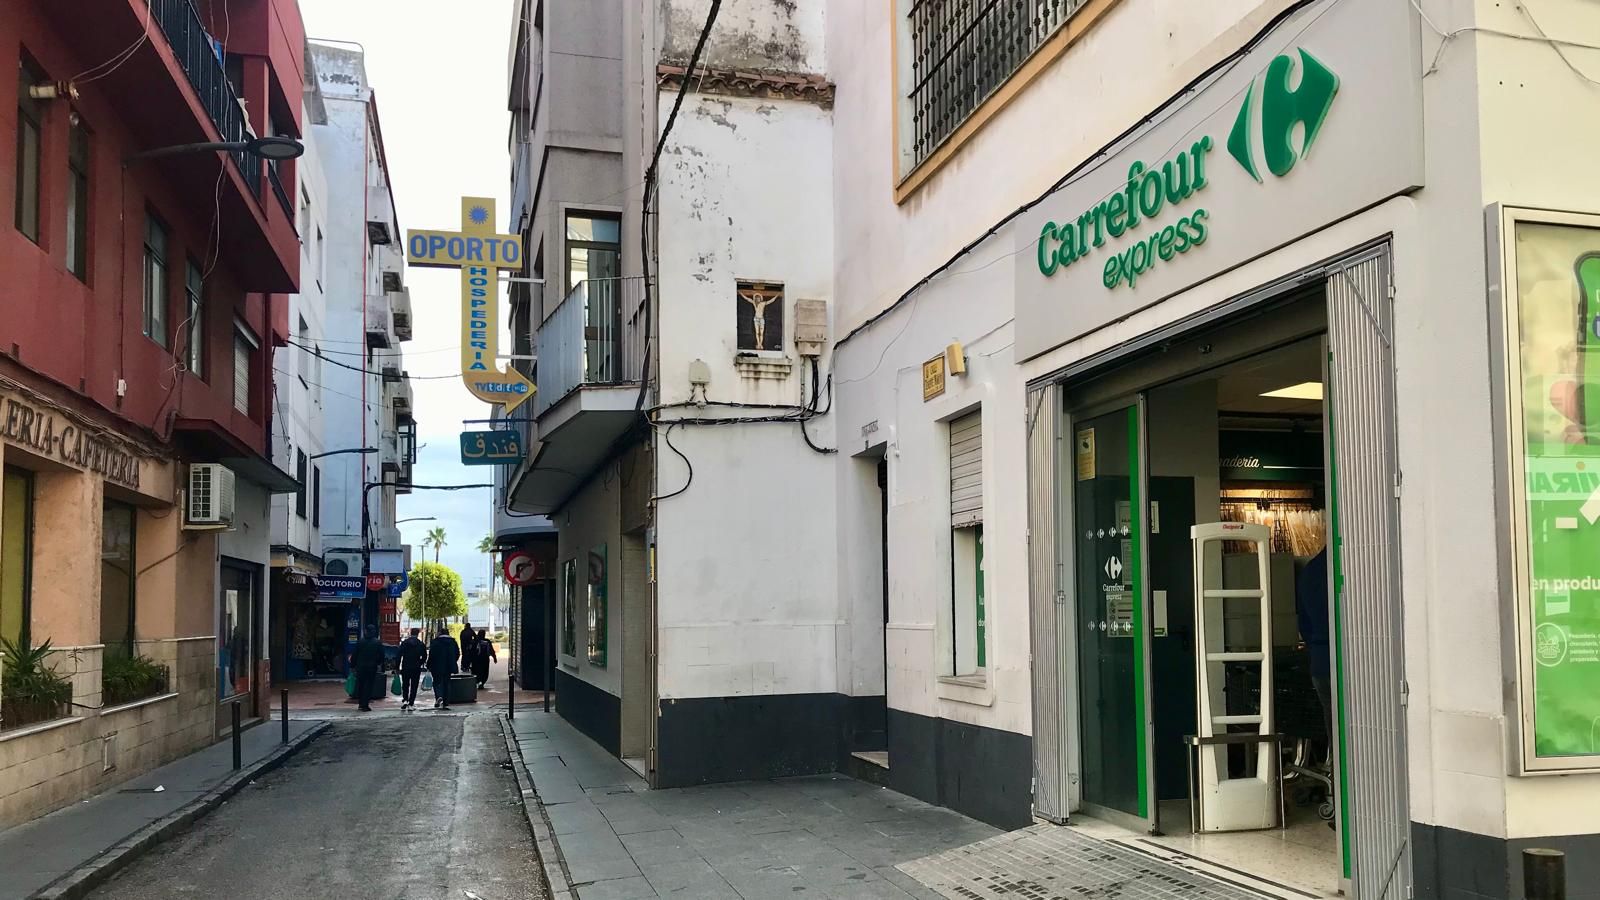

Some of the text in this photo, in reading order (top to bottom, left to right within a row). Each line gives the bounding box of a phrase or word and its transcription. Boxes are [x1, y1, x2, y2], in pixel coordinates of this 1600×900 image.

[1037, 135, 1213, 277] Carrefour
[410, 234, 519, 263] OPORTO
[1103, 208, 1209, 289] express
[470, 267, 487, 370] HOSPEDERIA
[463, 433, 519, 458] فندق
[318, 580, 362, 588] OCUTORIO
